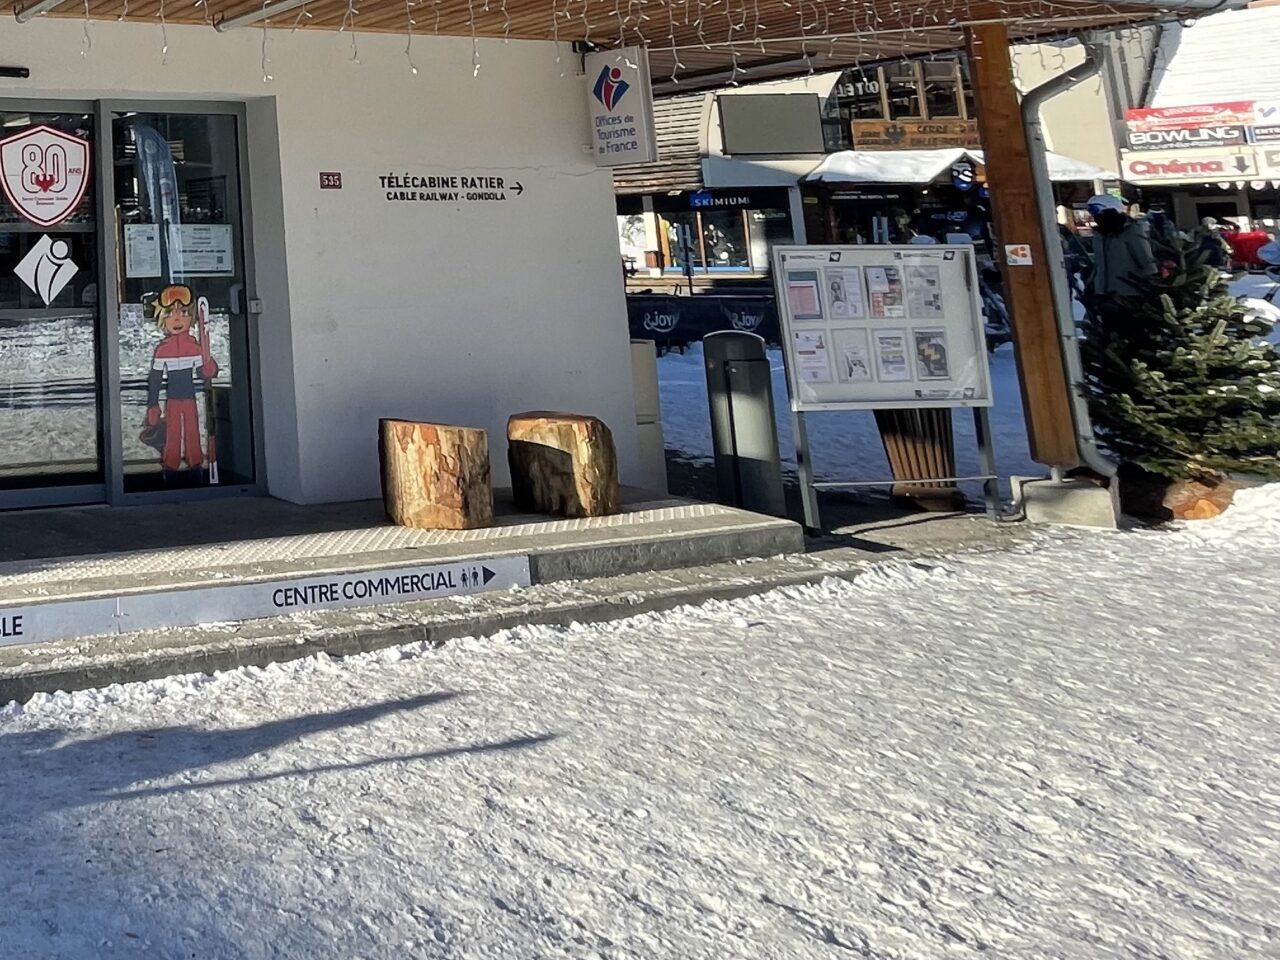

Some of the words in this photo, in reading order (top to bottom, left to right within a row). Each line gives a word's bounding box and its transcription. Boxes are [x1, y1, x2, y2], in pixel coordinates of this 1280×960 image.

[595, 115, 622, 127] Offices
[624, 114, 634, 123] de
[597, 127, 636, 140] Tourisme
[1129, 126, 1240, 144] BOWLING
[606, 140, 638, 153] France
[22, 143, 68, 194] 80
[1129, 159, 1225, 176] Cinéma
[322, 175, 340, 186] 535
[379, 172, 458, 189] TÉLÉCABINE
[461, 176, 505, 189] RATIER
[386, 192, 417, 201] CABLE
[419, 192, 459, 201] RAILWAY
[466, 192, 506, 201] GONDOLA
[694, 196, 748, 207] SKIMIUM
[272, 583, 340, 609] CENTRE
[342, 573, 457, 600] COMMERCIAL
